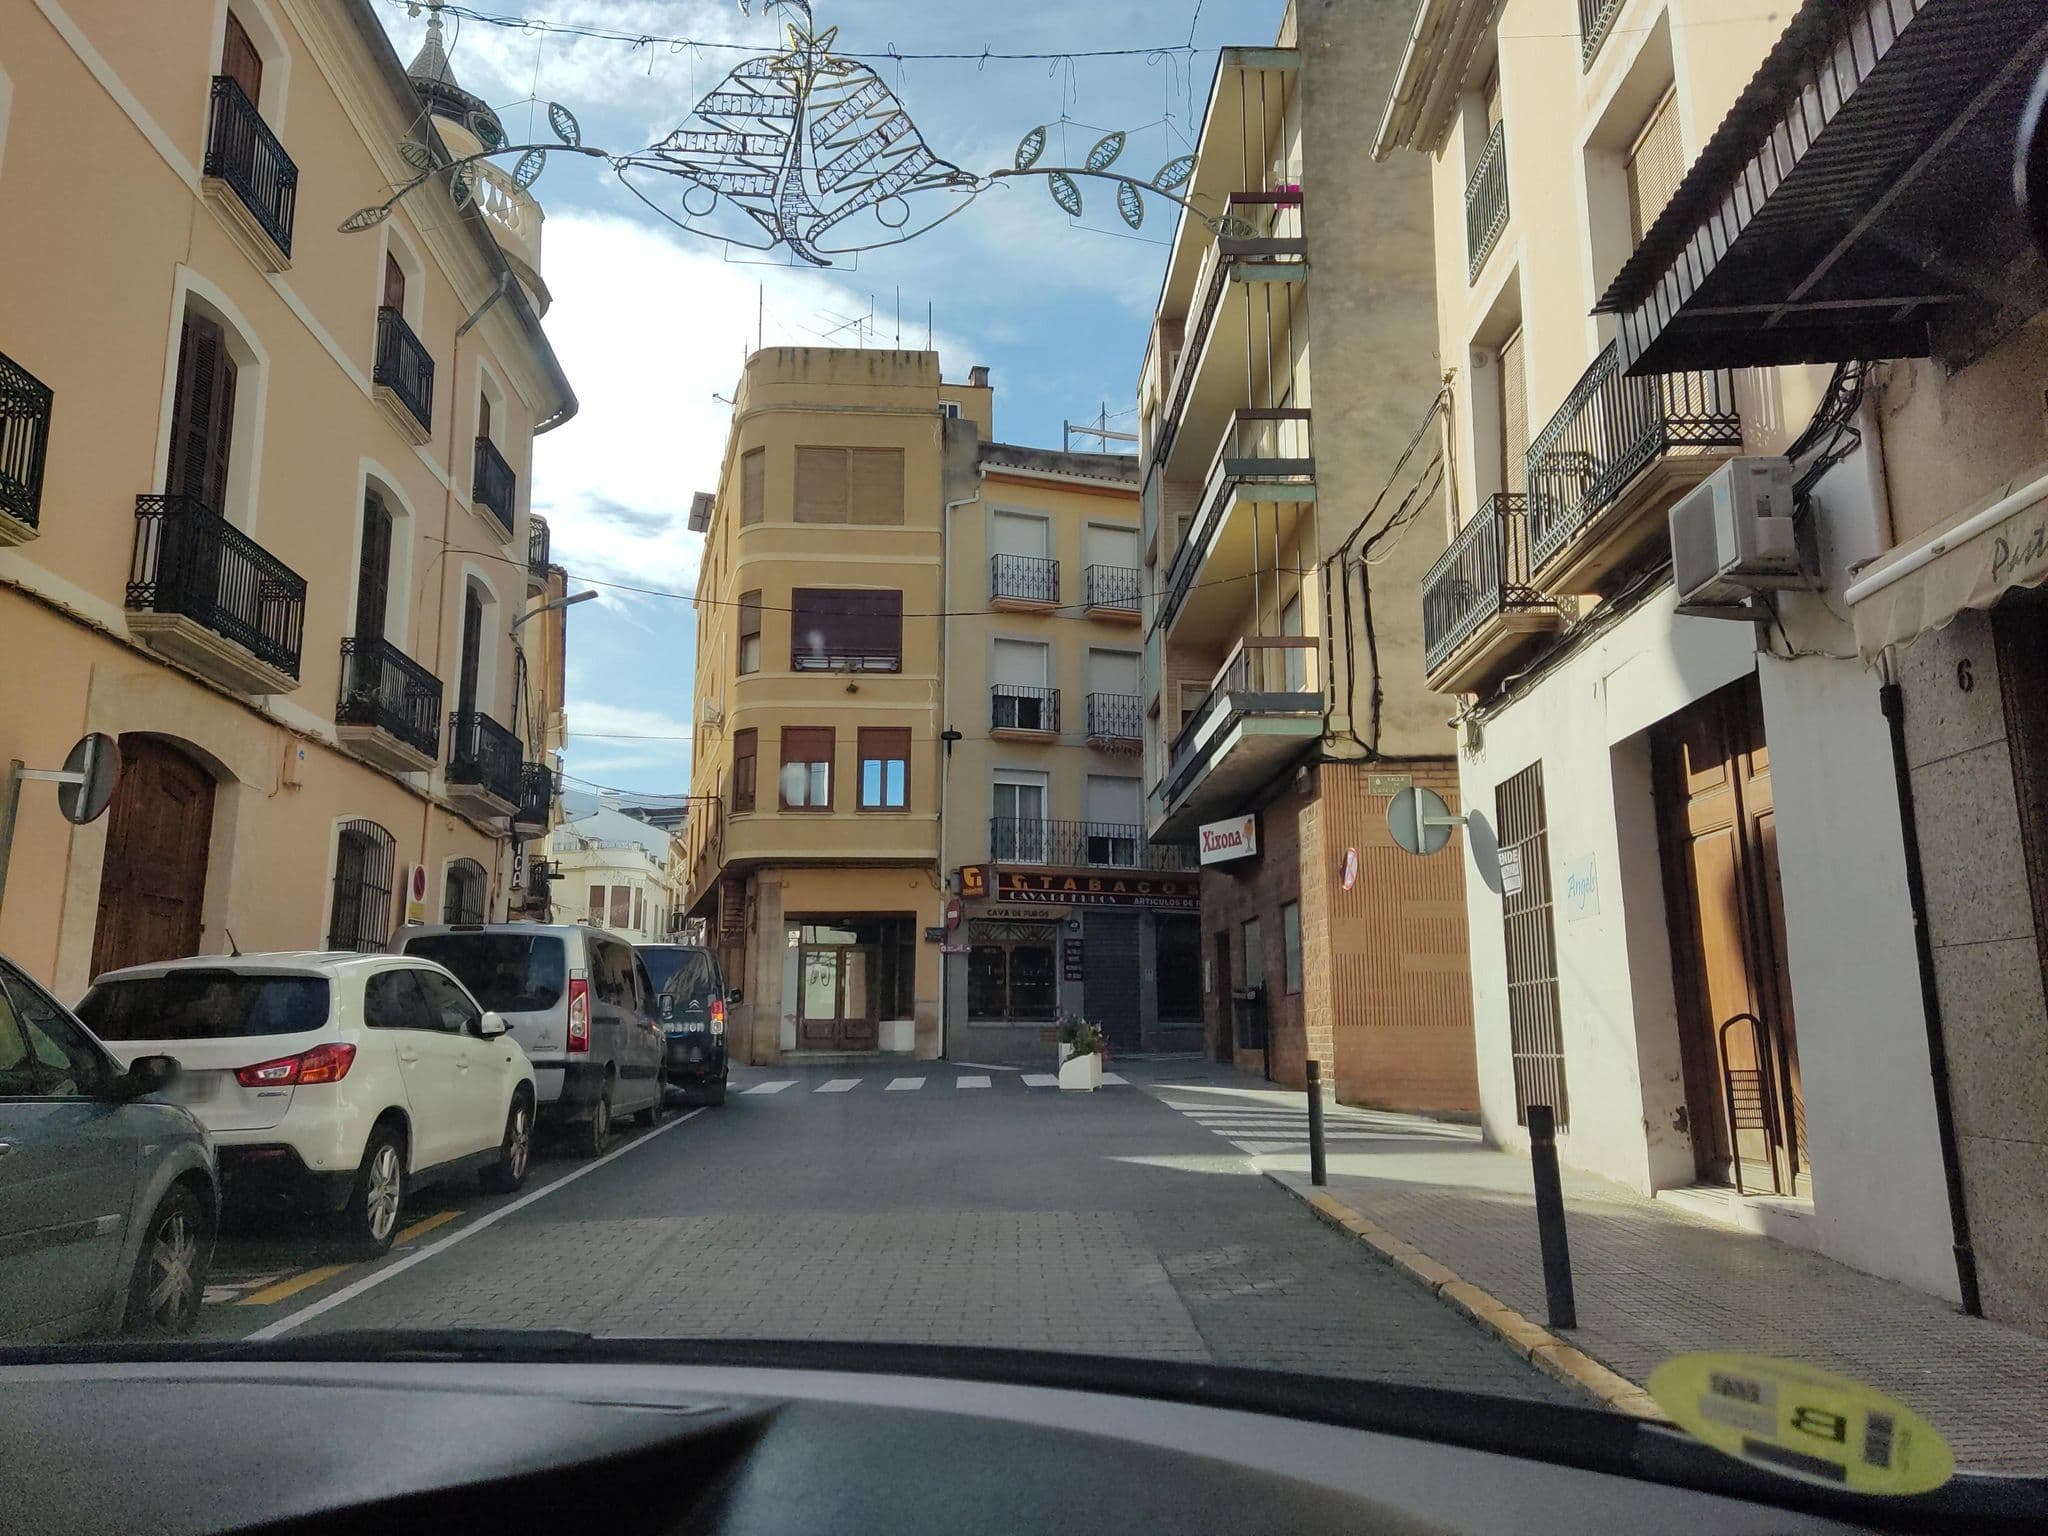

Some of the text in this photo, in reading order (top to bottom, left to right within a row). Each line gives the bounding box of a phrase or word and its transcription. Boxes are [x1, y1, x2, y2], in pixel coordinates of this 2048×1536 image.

[1956, 658, 1974, 692] 6
[1202, 830, 1242, 853] Xixona
[1498, 849, 1518, 865] ENDE
[1009, 891, 1047, 901] CAVA
[1134, 897, 1180, 906] ARTICULOS
[987, 909, 1010, 917] CAVA
[1023, 910, 1049, 918] PUROS
[662, 1022, 705, 1033] mazon
